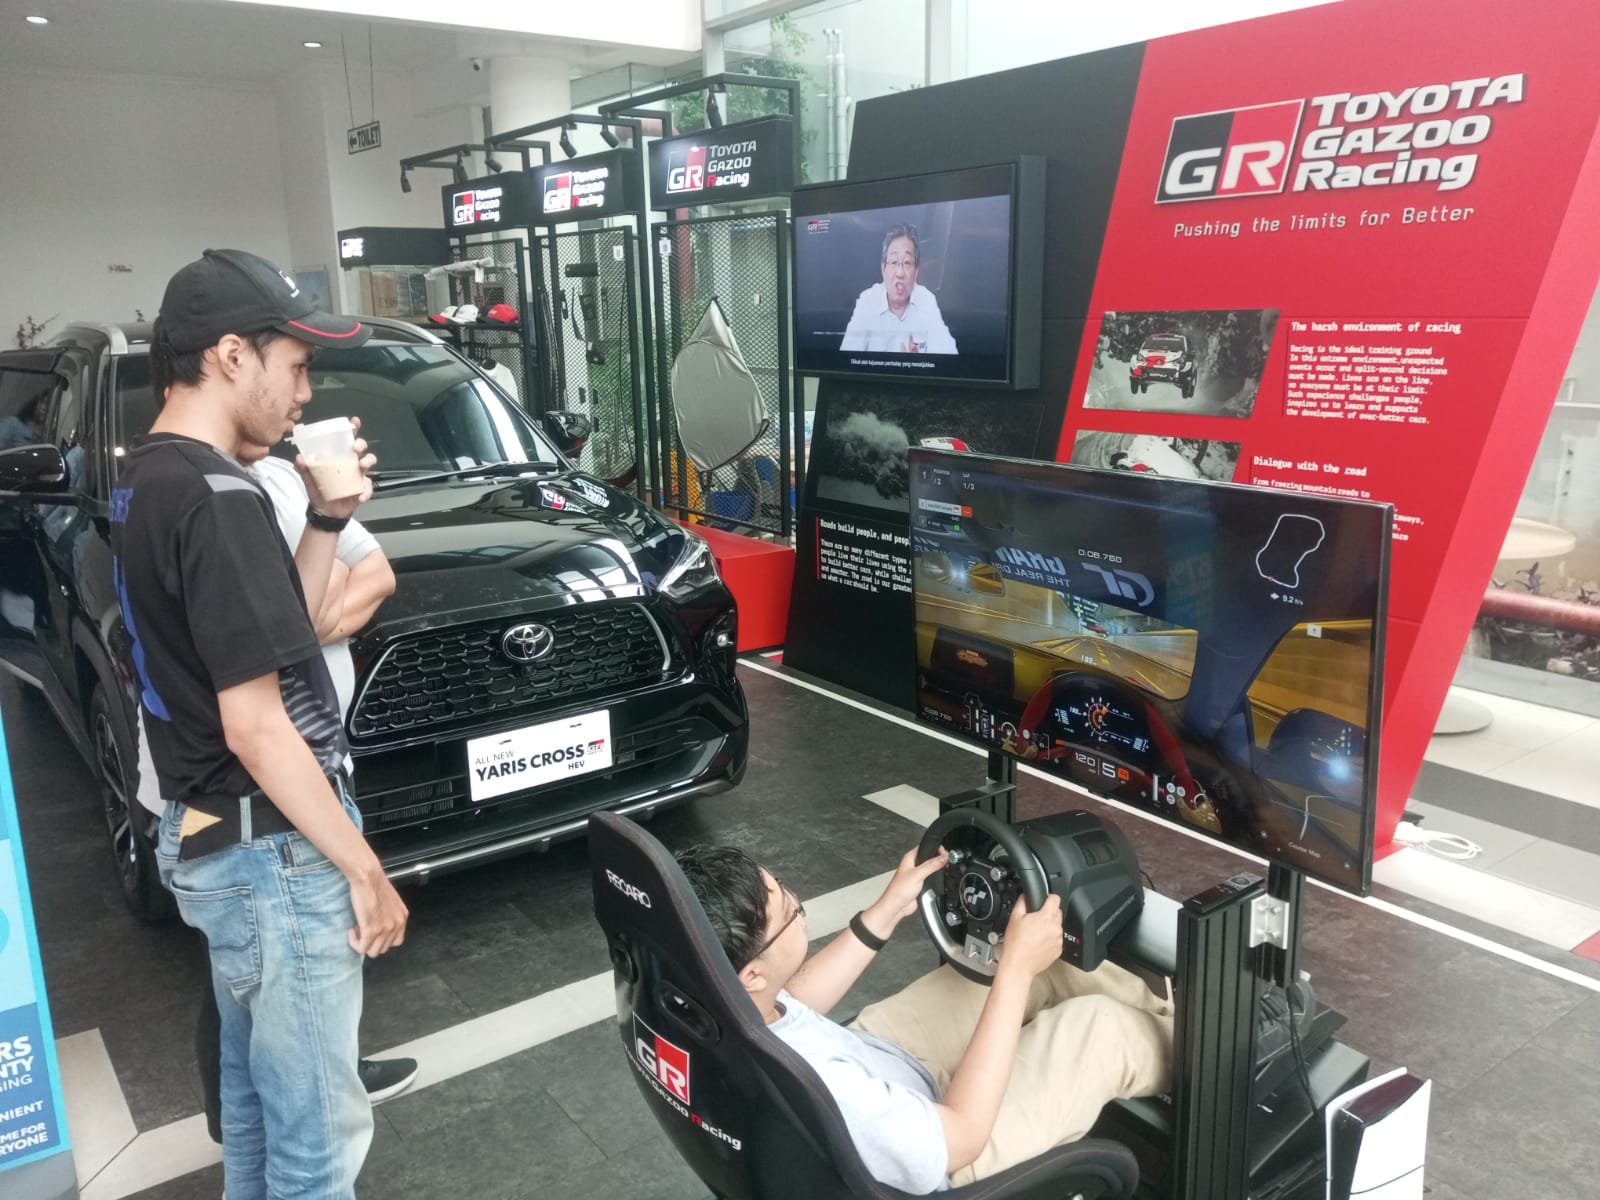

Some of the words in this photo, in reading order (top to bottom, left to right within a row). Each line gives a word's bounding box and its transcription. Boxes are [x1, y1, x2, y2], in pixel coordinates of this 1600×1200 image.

[1311, 73, 1524, 127] TOYOTA
[357, 126, 379, 148] TOILET
[709, 140, 757, 157] TOYOTA
[1164, 140, 1286, 196] GR
[1301, 114, 1491, 160] GAZOO
[669, 165, 702, 190] GR
[707, 156, 751, 173] GAZOO
[706, 171, 750, 187] Racing
[1292, 152, 1479, 192] Racing
[1173, 220, 1241, 239] Pushing
[1251, 217, 1280, 233] the
[1290, 212, 1347, 231] limits
[1358, 209, 1391, 227] for
[1401, 206, 1475, 225] Better
[1292, 321, 1307, 332] The
[1311, 321, 1338, 332] harsh
[1342, 322, 1402, 333] environment
[1408, 321, 1420, 332] of
[1425, 322, 1462, 335] racing
[1253, 456, 1293, 469] Dialogue
[1297, 461, 1319, 471] with
[1323, 463, 1340, 474] the
[1344, 467, 1367, 477] road
[1252, 477, 1270, 486] From
[1271, 479, 1303, 491] freezing
[1337, 488, 1359, 497] roads
[1361, 490, 1370, 498] to
[881, 532, 893, 542] and
[475, 755, 490, 765] ALL
[493, 750, 515, 761] NEW
[475, 758, 527, 782] YARIS
[530, 744, 585, 768] CROSS
[568, 760, 585, 770] HEV
[605, 869, 652, 908] RECARO
[637, 1037, 687, 1100] GR
[651, 1080, 689, 1118] GAZOO
[690, 1112, 742, 1151] Racing
[21, 1122, 46, 1137] FOR
